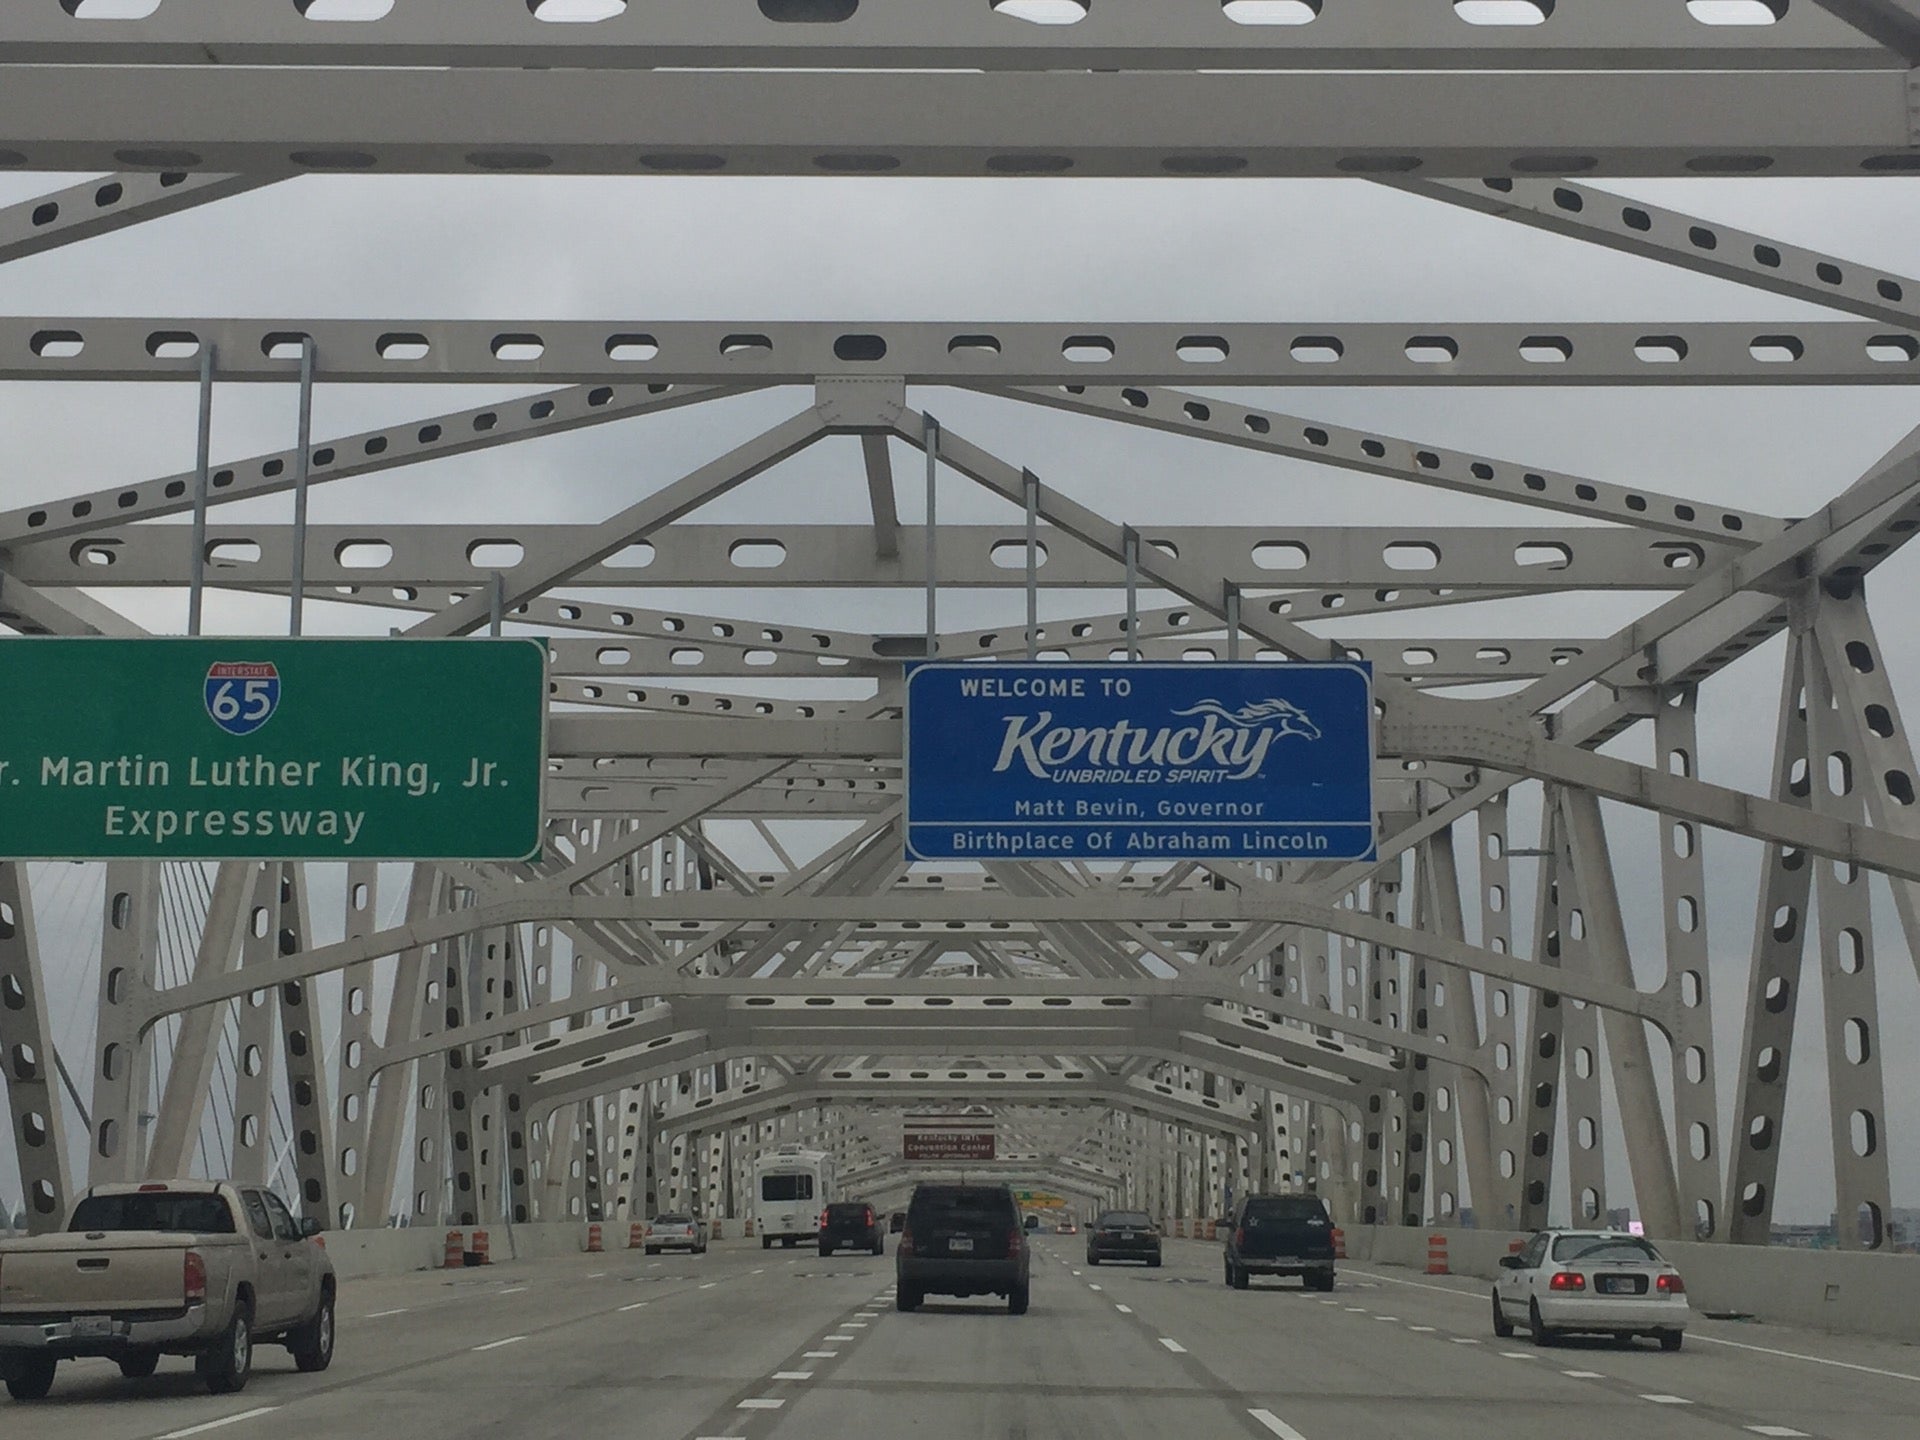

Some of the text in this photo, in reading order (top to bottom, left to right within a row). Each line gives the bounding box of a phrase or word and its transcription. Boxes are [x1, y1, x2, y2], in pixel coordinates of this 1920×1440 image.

[217, 665, 270, 677] INTERSTATE
[960, 678, 1131, 697] WELCOME TO
[212, 681, 271, 721] 65
[992, 711, 1275, 780] Kentucky
[41, 755, 170, 787] Martin
[190, 755, 321, 787] Luther
[342, 755, 441, 796] King,
[462, 757, 508, 787] Jr.
[1052, 769, 1229, 783] UNBRIDLED SPIRIT
[1015, 799, 1264, 818] Matt Bevin, Governor
[105, 805, 366, 843] Expressway
[953, 830, 1328, 854] Birthplace Of Abraham Lincoln
